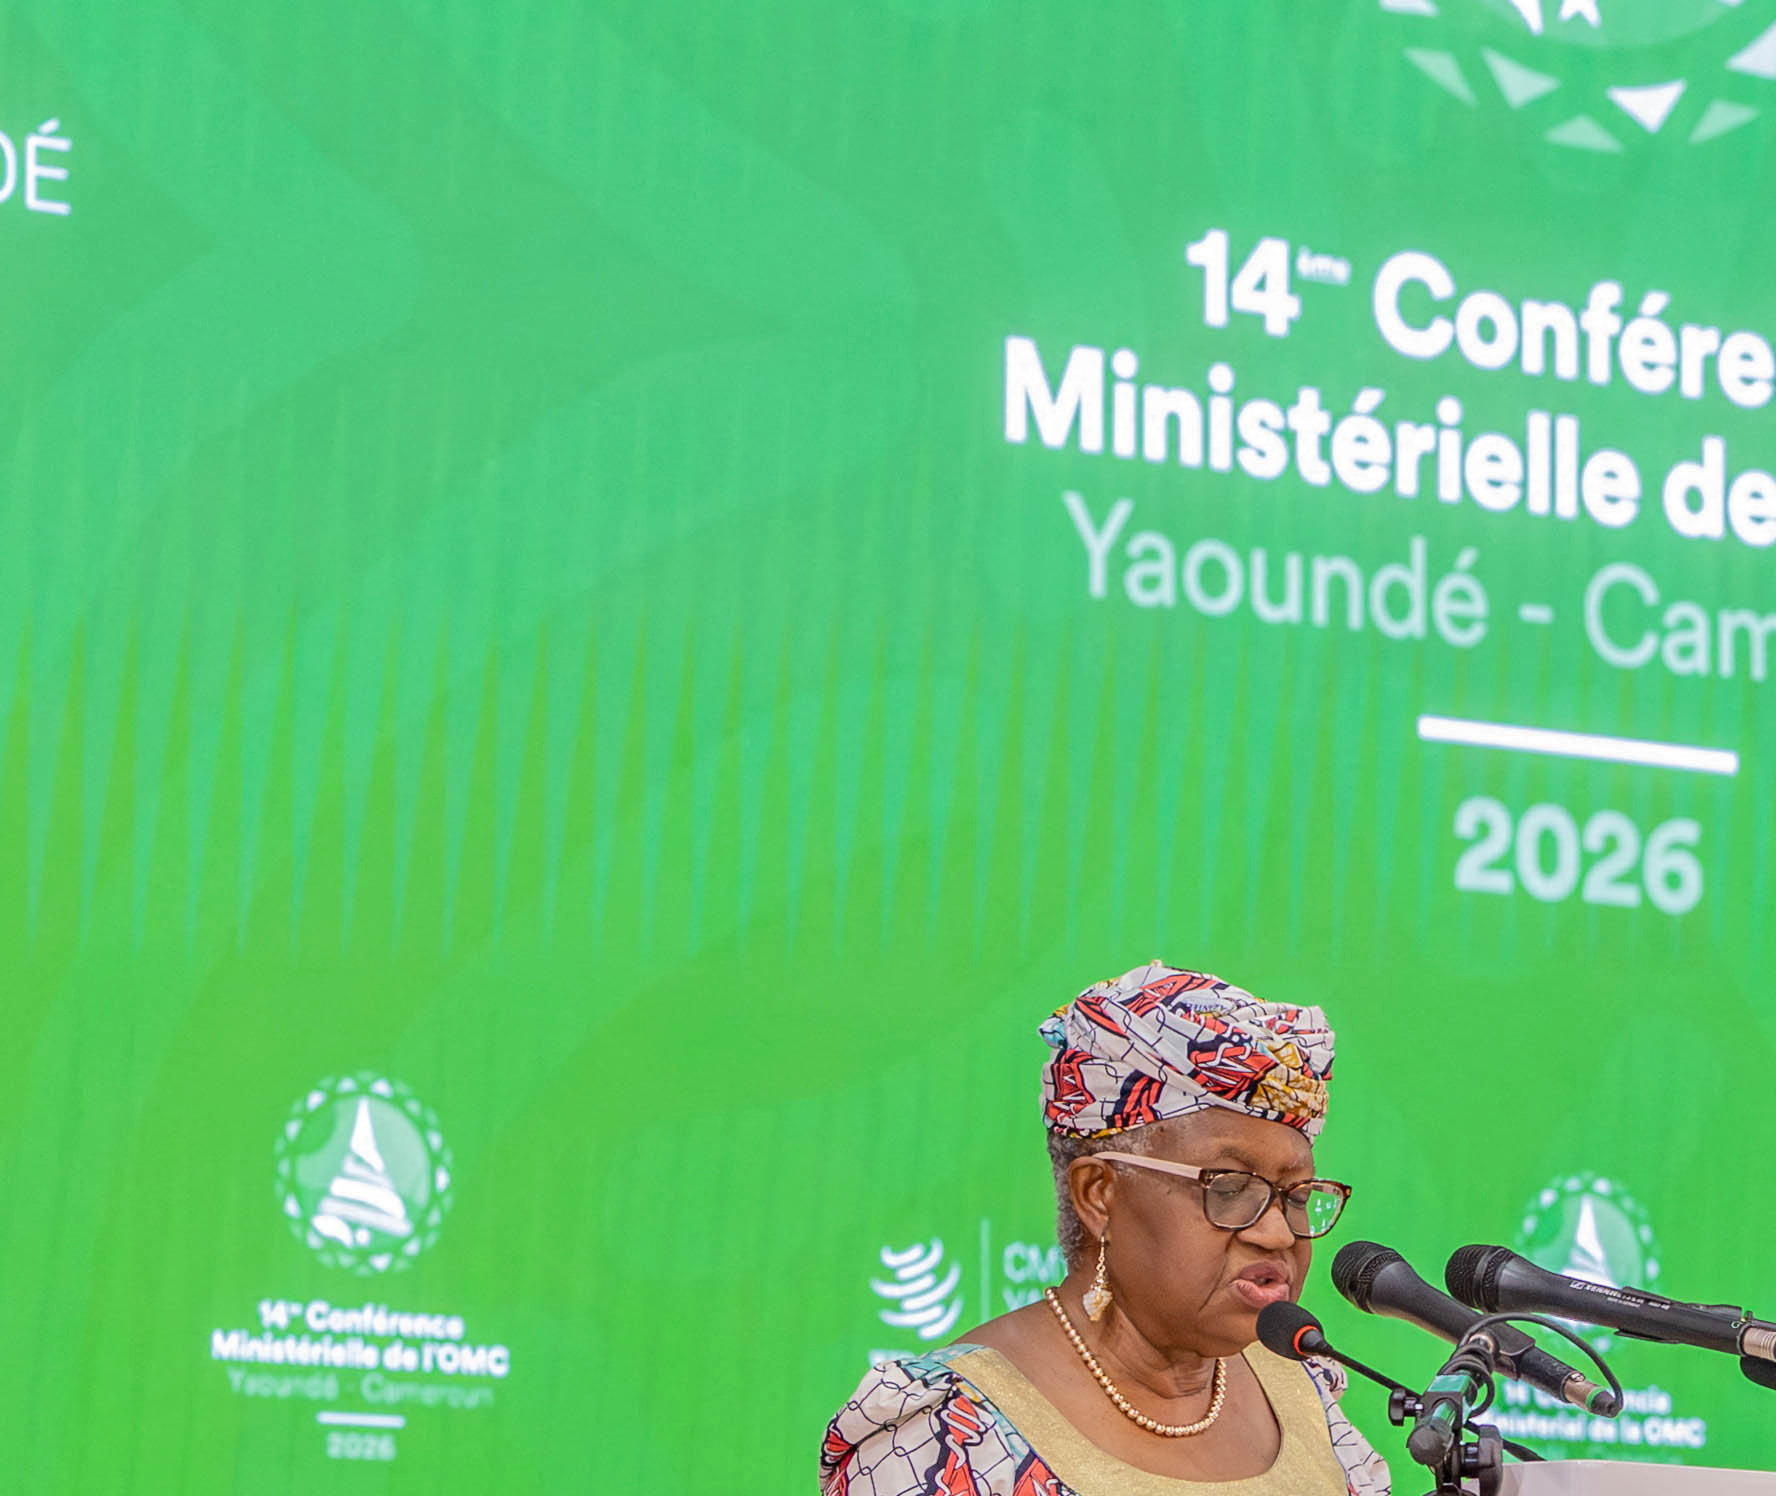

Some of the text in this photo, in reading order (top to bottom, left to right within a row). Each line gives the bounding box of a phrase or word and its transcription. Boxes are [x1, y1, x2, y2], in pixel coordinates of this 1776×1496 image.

[1004, 335, 1642, 527] Ministérielle
[1063, 491, 1489, 648] Yaoundé
[1453, 797, 1704, 916] 2026
[1002, 1240, 1068, 1283] CM
